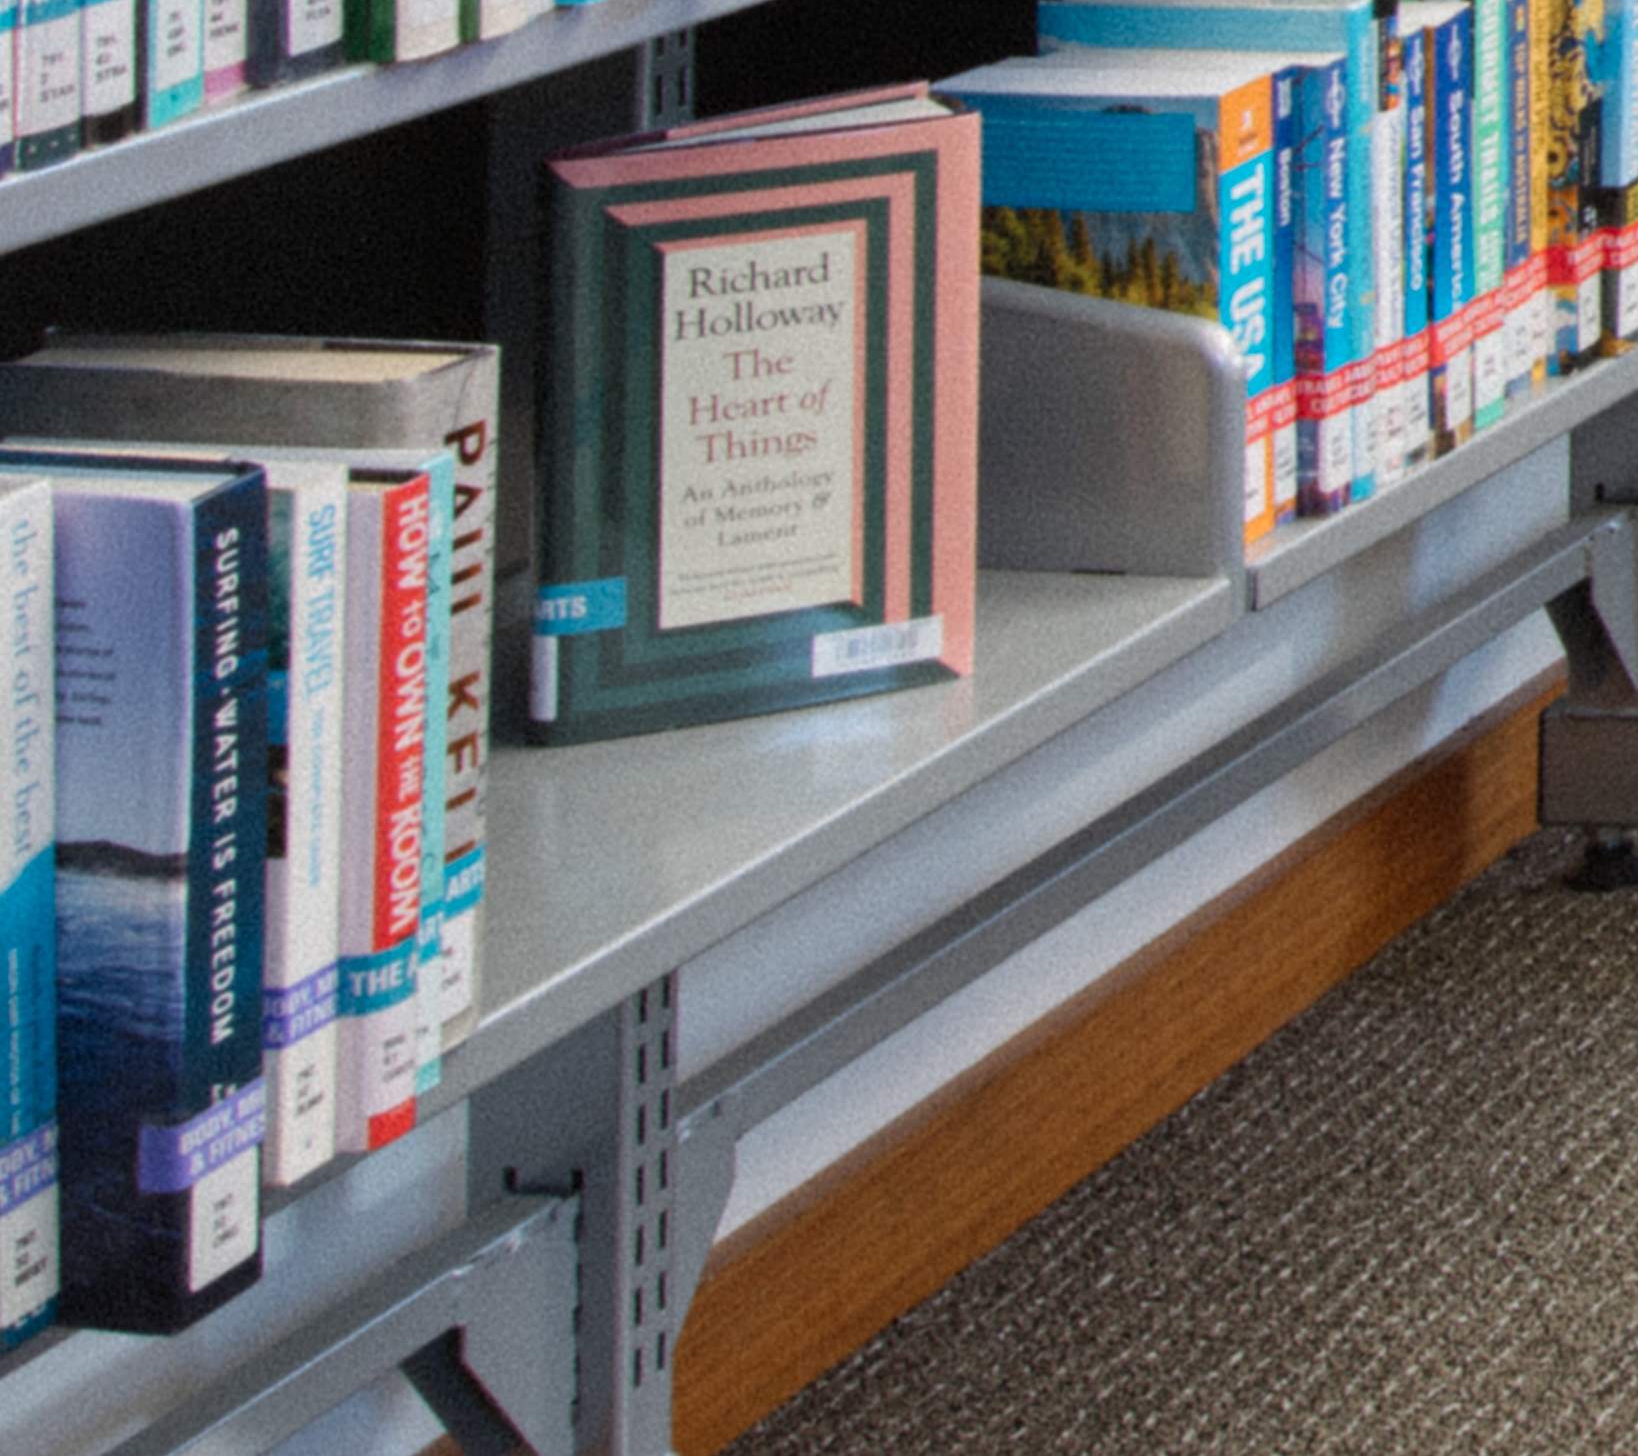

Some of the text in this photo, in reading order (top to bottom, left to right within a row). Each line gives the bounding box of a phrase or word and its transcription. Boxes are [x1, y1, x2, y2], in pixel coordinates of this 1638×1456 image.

[1230, 163, 1265, 275] THE
[1277, 148, 1295, 227] Boston
[1407, 104, 1426, 290] San Francisco
[1478, 133, 1500, 227] TRAILS
[1328, 138, 1348, 328] New York City
[686, 251, 831, 299] Richard
[672, 298, 846, 343] Holloway
[722, 348, 796, 383] The
[688, 386, 831, 427] Heart of
[679, 467, 836, 506] An Anthology
[695, 426, 820, 468] Things
[682, 506, 708, 529] of
[714, 497, 803, 527] Memory
[304, 504, 336, 700] SURF TRAVEL
[387, 494, 428, 935] HOW TO OWN THE ROOM
[209, 526, 240, 1045] SURFING WATER IS FREEDOM
